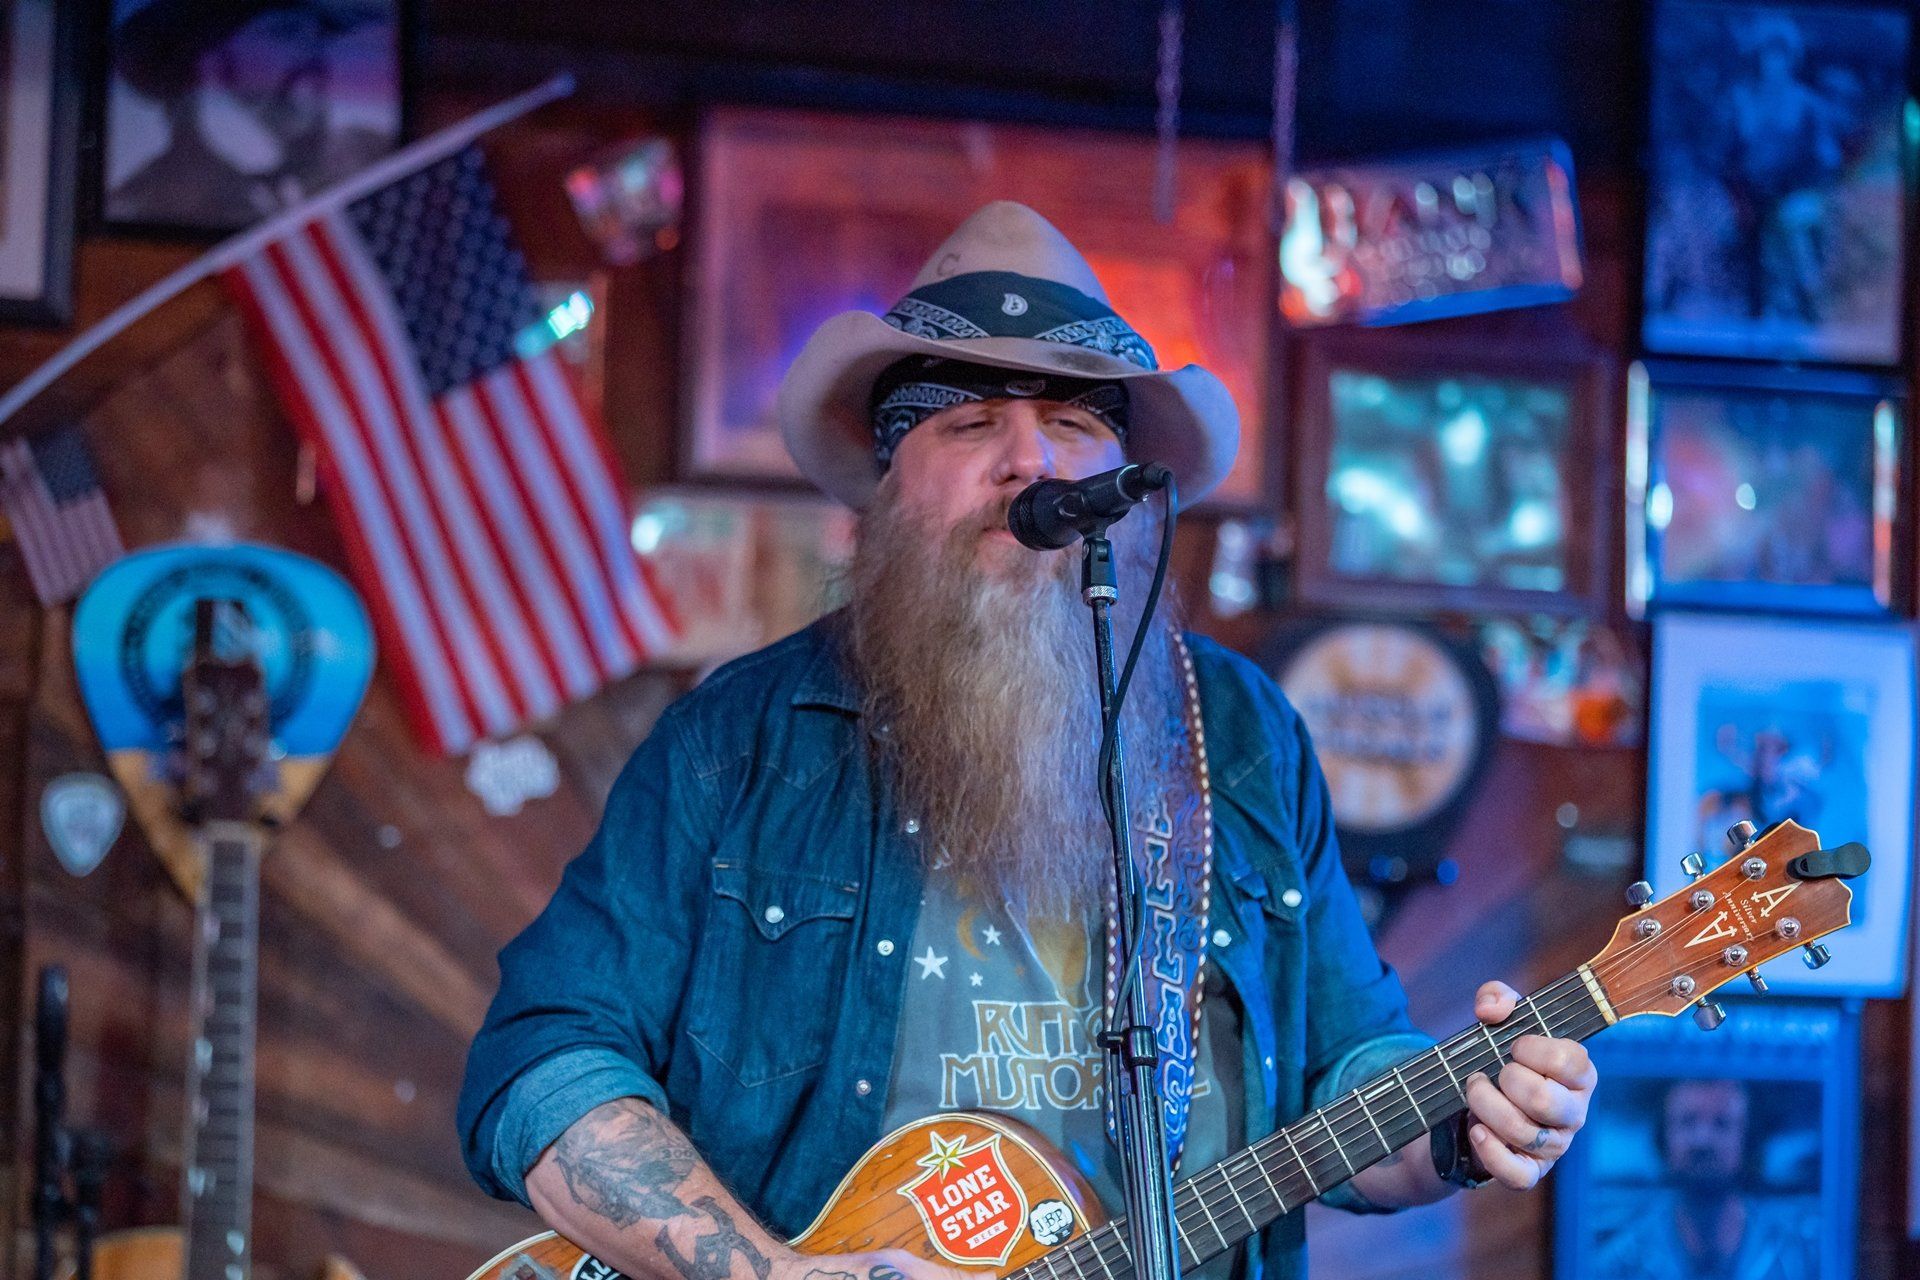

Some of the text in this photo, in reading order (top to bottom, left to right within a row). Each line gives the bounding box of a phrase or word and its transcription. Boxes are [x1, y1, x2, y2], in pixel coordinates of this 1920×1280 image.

[1740, 899, 1757, 924] Silver
[927, 1164, 997, 1217] LONE
[941, 1190, 1011, 1241] STAR
[973, 1225, 1000, 1244] BEER
